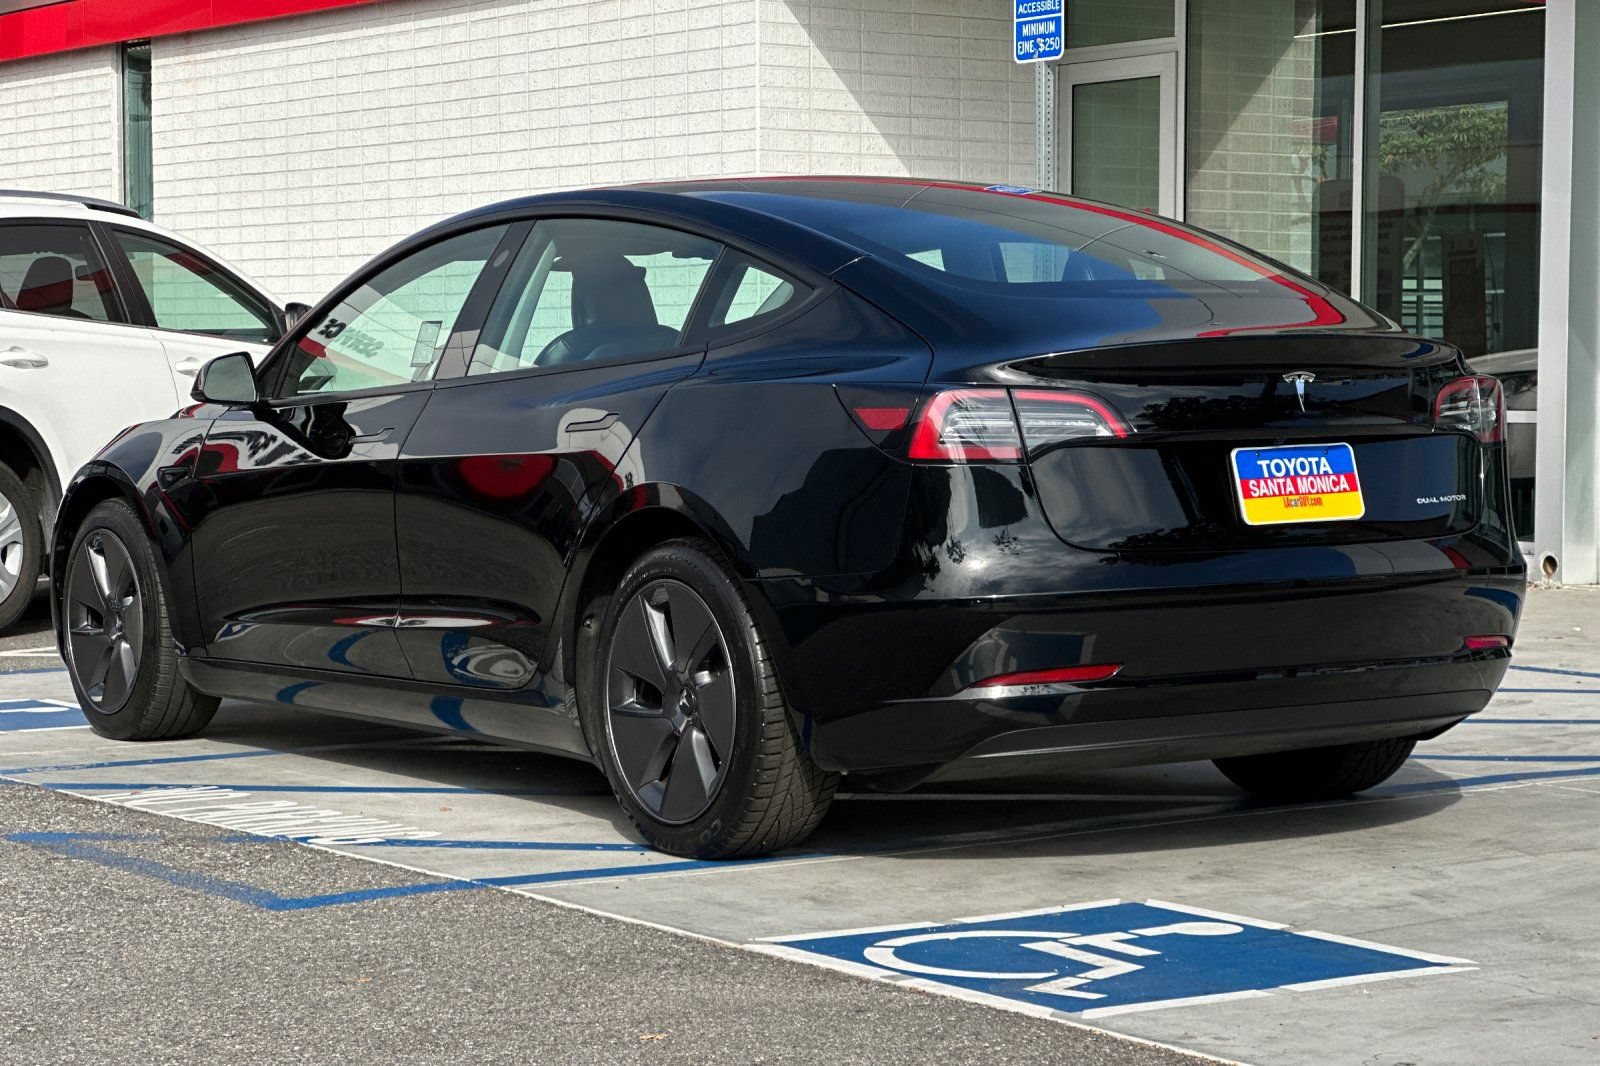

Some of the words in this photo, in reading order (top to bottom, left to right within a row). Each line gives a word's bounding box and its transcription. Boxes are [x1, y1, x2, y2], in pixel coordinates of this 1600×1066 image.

[1022, 20, 1056, 36] MINIMUM
[1017, 40, 1035, 55] FINE
[1038, 37, 1060, 52] $250
[1257, 456, 1333, 477] TOYOTA
[1249, 478, 1296, 497] SANTA
[1297, 474, 1350, 494] MONICA
[1440, 494, 1467, 502] MOTOR
